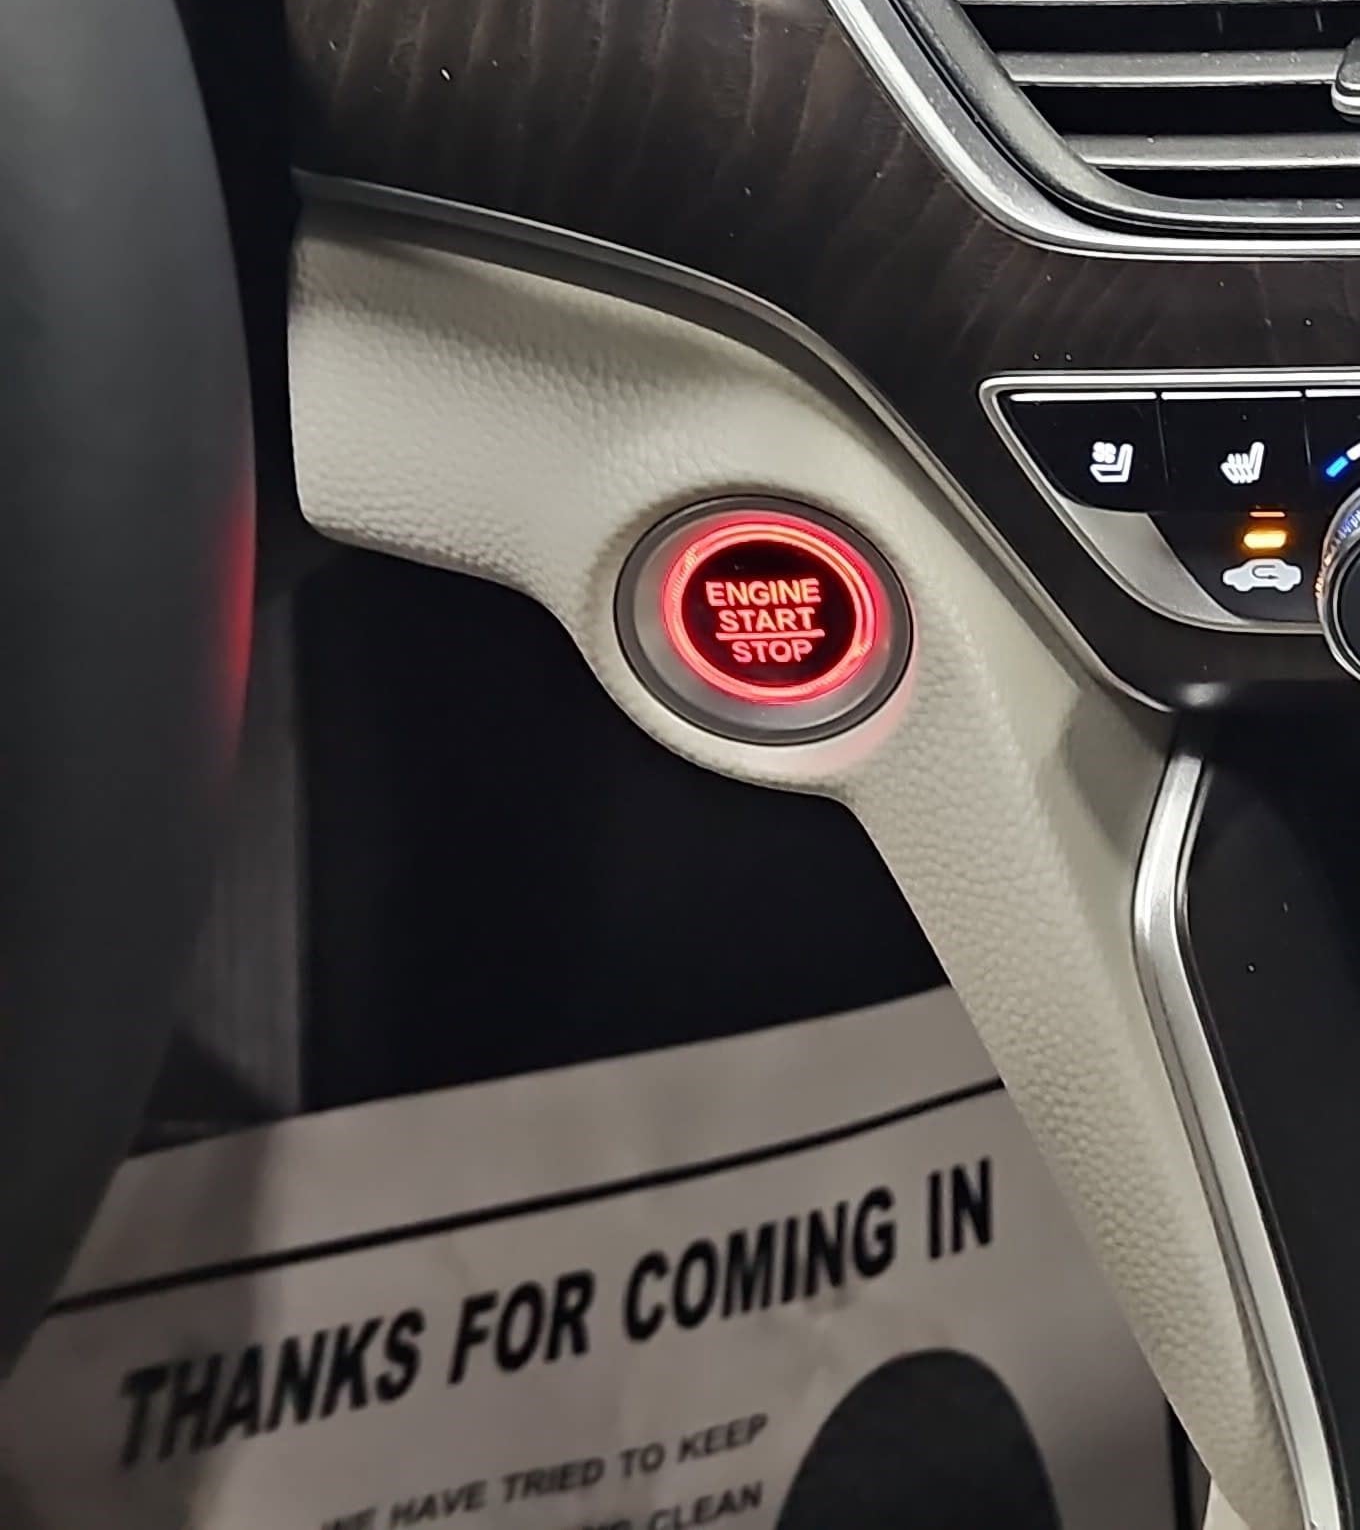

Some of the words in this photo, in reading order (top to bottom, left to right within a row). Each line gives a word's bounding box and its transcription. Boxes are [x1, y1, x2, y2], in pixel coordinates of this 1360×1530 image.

[705, 577, 821, 607] ENGINE
[719, 606, 816, 633] START
[731, 639, 813, 663] STOP
[119, 1312, 420, 1469] THANKS
[447, 1269, 597, 1387] FOR
[621, 1185, 897, 1340] COMING
[926, 1157, 994, 1261] IN
[390, 1479, 488, 1529] HAVE
[502, 1457, 605, 1505] TRIED
[620, 1441, 666, 1480] TO
[678, 1412, 770, 1463] KEEP
[650, 1480, 764, 1530] CLEAN
